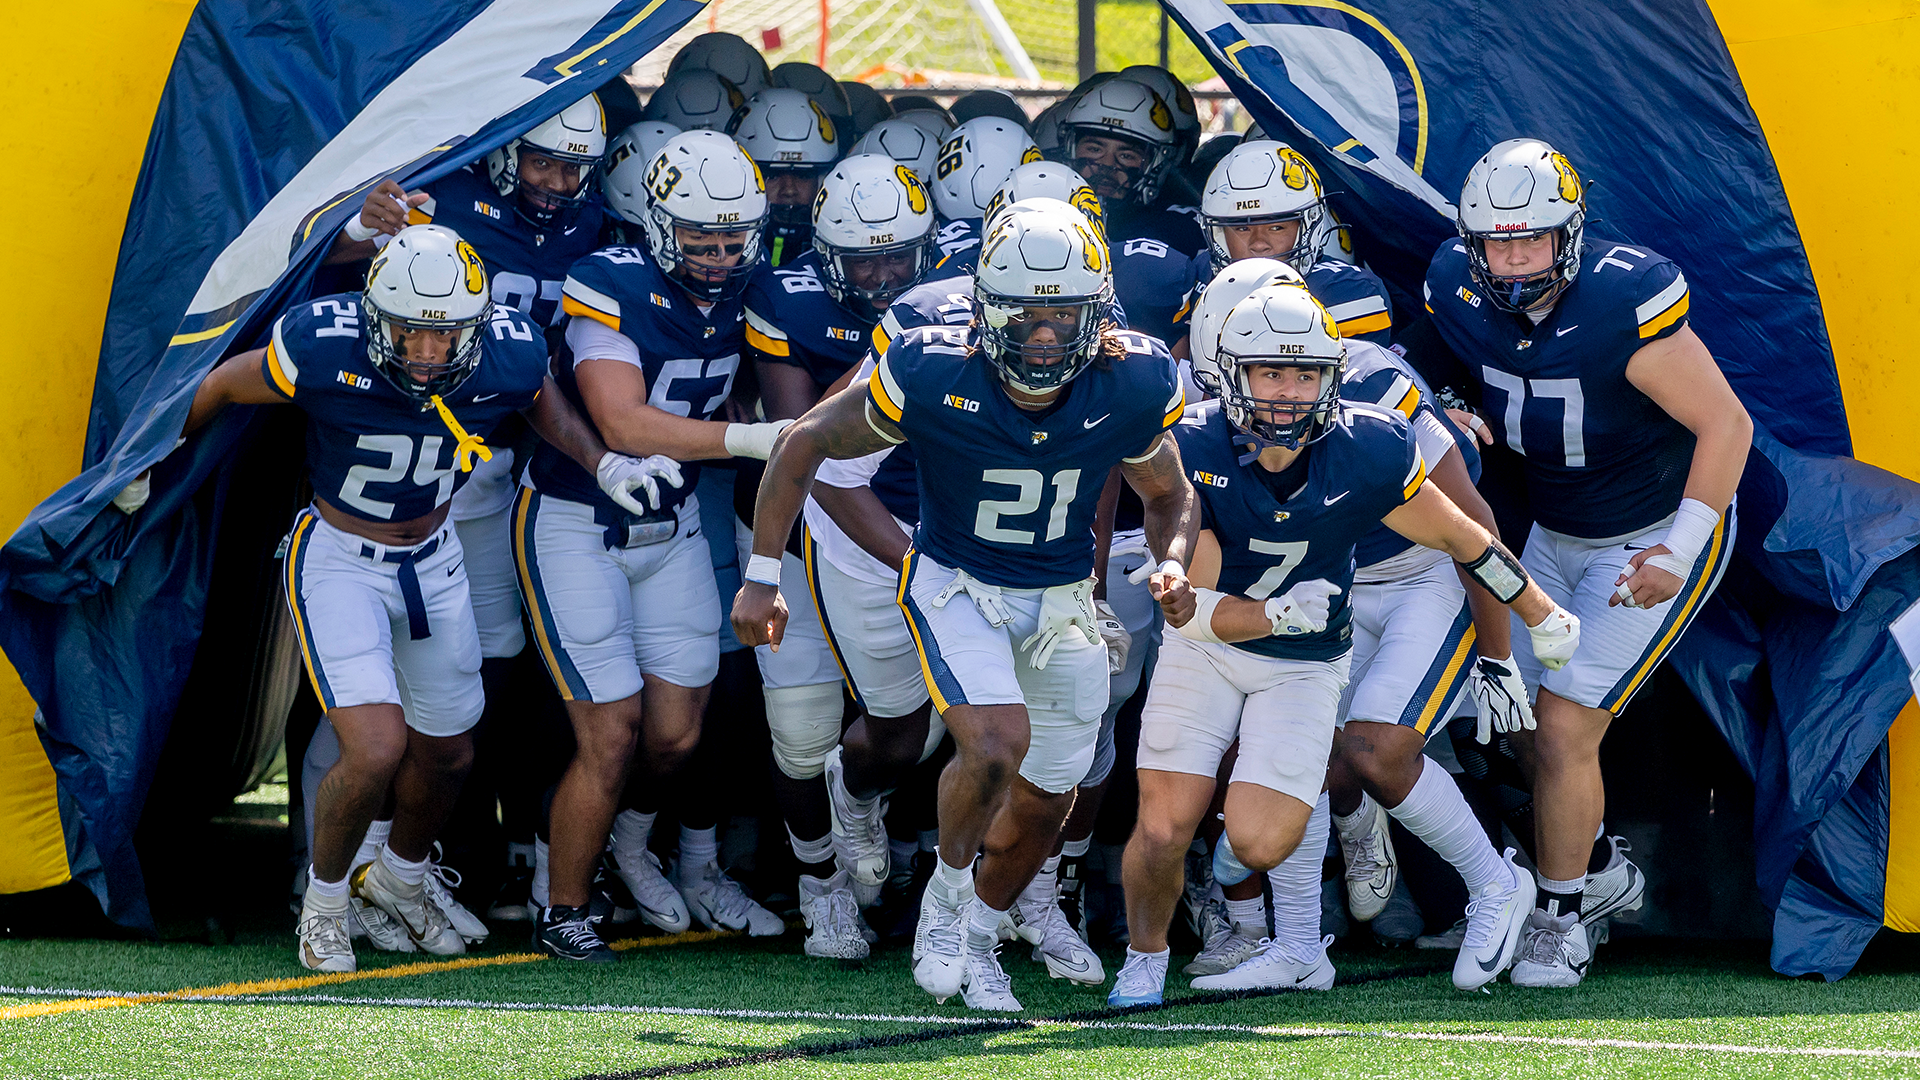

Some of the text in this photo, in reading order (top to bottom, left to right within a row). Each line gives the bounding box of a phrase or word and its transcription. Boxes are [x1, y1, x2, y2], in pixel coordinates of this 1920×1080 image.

[567, 142, 589, 153] PACE
[936, 134, 965, 181] 56
[646, 152, 683, 202] 53
[474, 200, 501, 220] NE10
[1236, 199, 1260, 211] PACE
[717, 212, 740, 223] PACE
[1494, 221, 1528, 232] Riddell
[869, 233, 894, 245] PACE
[1592, 245, 1648, 274] 77
[772, 264, 826, 294] 78
[1034, 284, 1061, 295] PACE
[1455, 285, 1482, 309] NE10
[650, 292, 672, 310] NE10
[311, 299, 360, 339] 24
[421, 309, 447, 320] PACE
[825, 326, 861, 342] NE10
[1279, 344, 1305, 355] PACE
[336, 369, 372, 390] NE10
[942, 393, 981, 413] NE10
[1480, 364, 1586, 467] 77
[337, 433, 462, 520] 24
[1192, 469, 1229, 489] NE10
[973, 468, 1082, 545] 21
[1244, 537, 1310, 600] 7
